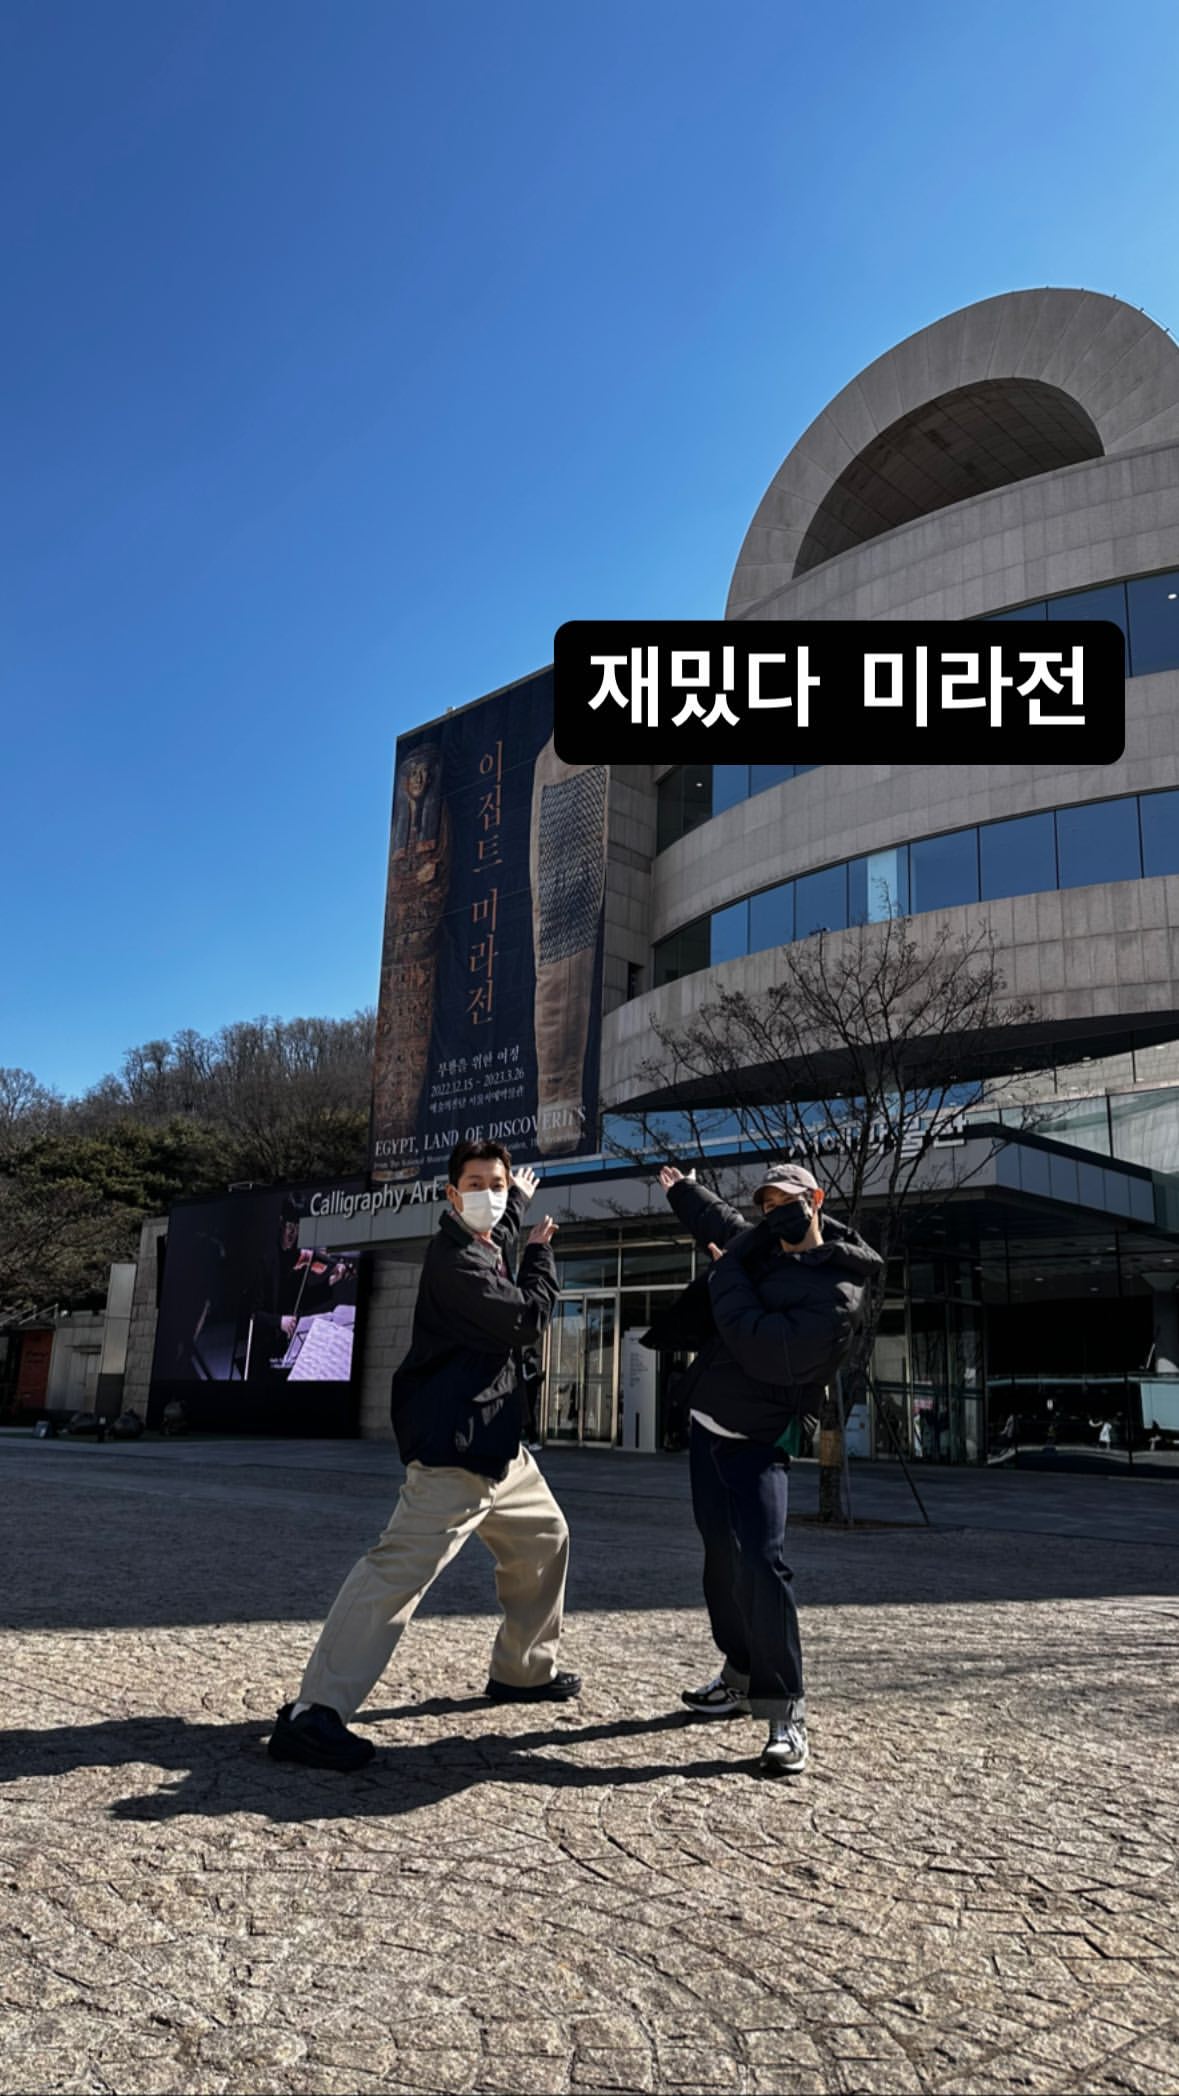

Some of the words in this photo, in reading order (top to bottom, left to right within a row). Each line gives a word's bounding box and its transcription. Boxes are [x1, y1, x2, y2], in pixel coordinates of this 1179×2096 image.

[472, 740, 504, 873] 이집트
[466, 887, 500, 1026] 미라전
[472, 1051, 493, 1071] 위한
[497, 1044, 519, 1065] 여정
[431, 1078, 474, 1098] 2022.12.15
[483, 1066, 525, 1088] 2023.3.26
[375, 1136, 419, 1157] EGYPT,
[424, 1129, 460, 1151] LAND
[465, 1124, 485, 1146] OF
[310, 1184, 404, 1218] Calligraphy
[410, 1177, 440, 1205] Art
